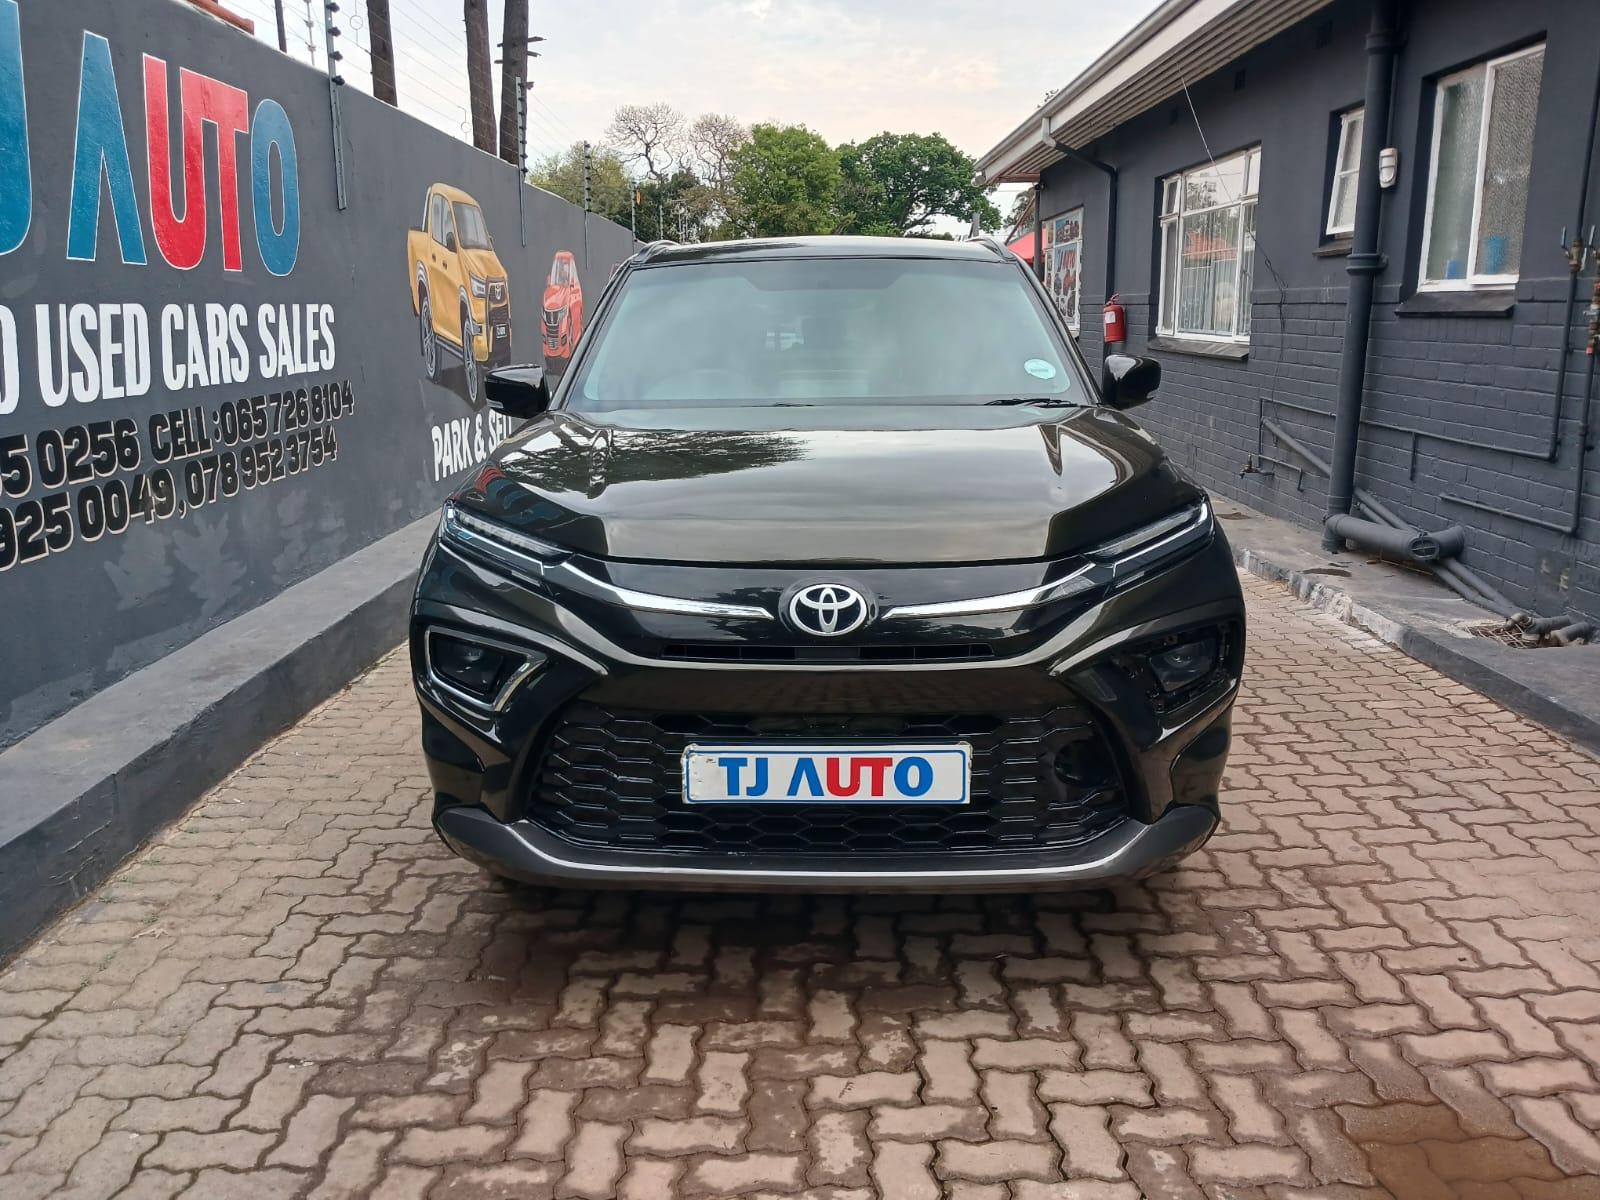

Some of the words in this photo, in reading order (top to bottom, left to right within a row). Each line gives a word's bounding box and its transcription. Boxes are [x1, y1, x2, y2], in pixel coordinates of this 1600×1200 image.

[66, 29, 300, 277] AUTO
[35, 303, 151, 407] USED
[161, 303, 250, 391] CARS
[257, 303, 336, 379] SALES
[36, 418, 141, 489] 0256
[431, 417, 473, 481] PARK
[474, 413, 486, 463] &
[718, 757, 769, 797] TJ
[786, 756, 934, 797] AUTO
